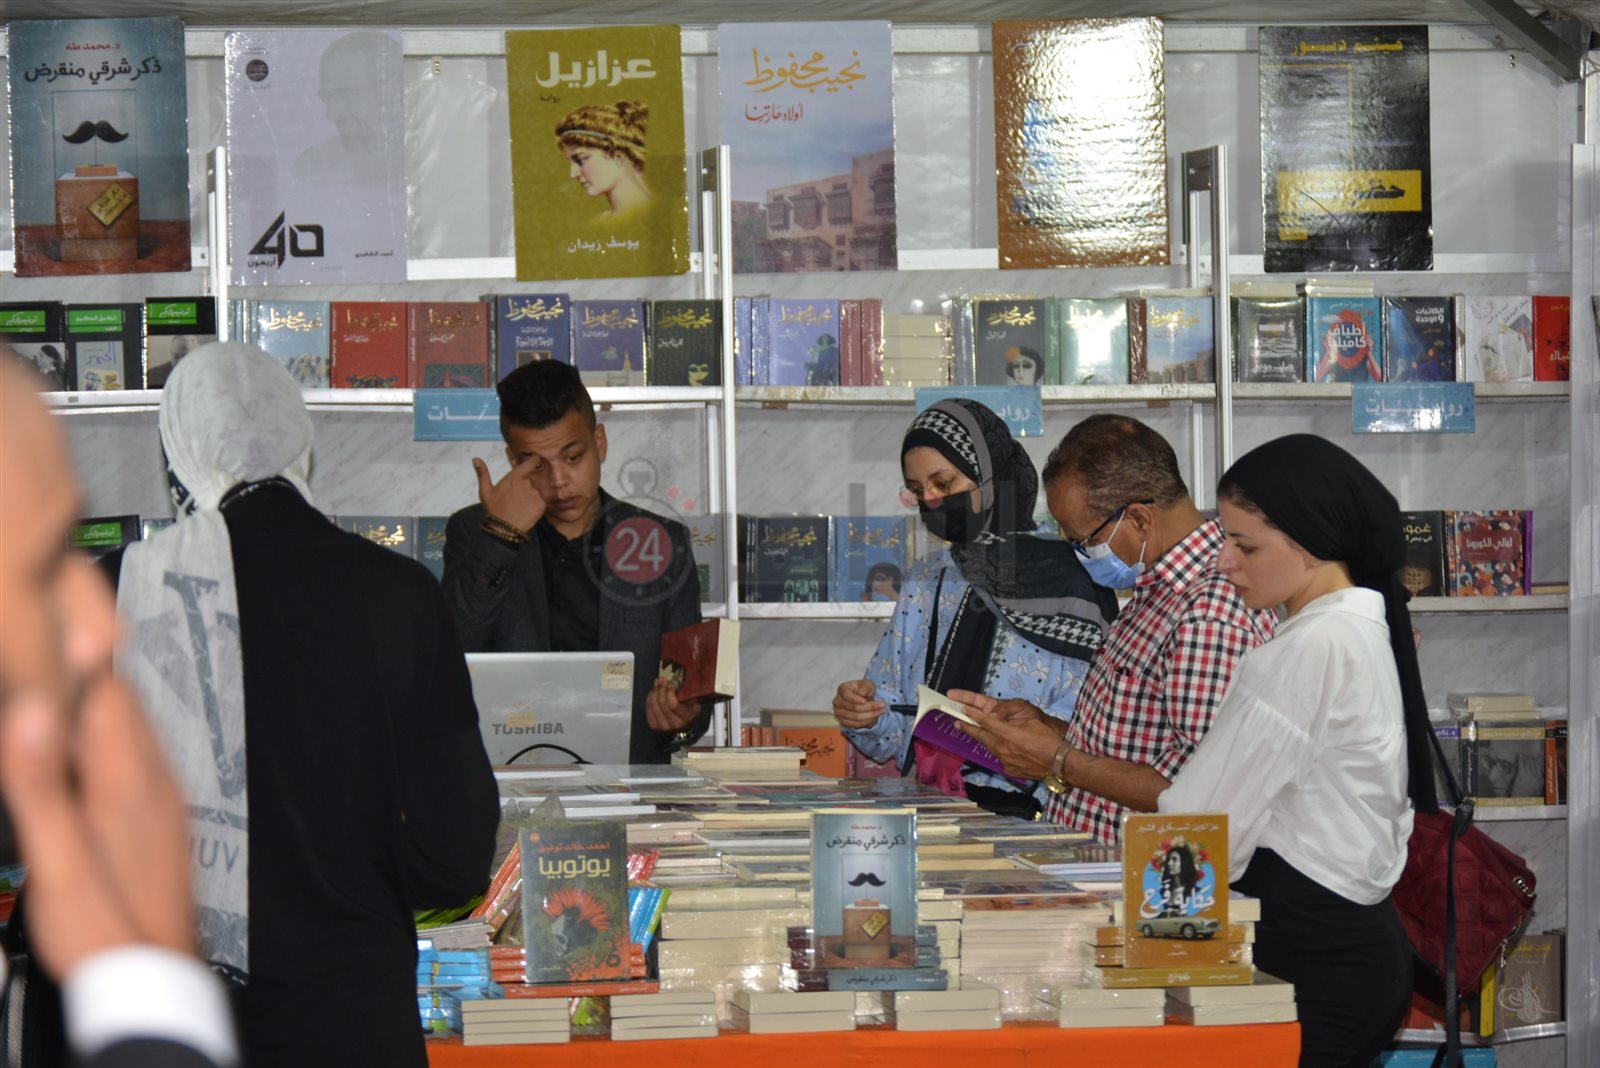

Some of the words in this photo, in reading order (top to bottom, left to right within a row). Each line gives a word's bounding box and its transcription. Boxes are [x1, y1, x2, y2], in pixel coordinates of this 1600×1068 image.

[24, 62, 85, 83] منقرض
[89, 58, 131, 85] شرقي
[130, 56, 162, 81] ذكر
[535, 49, 657, 89] عزازيل
[743, 47, 828, 94] محفوظ
[791, 50, 866, 94] نجيب
[567, 238, 602, 253] زيدان
[606, 235, 640, 251] يوسف
[505, 297, 546, 321] محفوظ
[528, 298, 564, 321] نجيب
[1466, 537, 1492, 550] الكورونا
[1493, 536, 1513, 550] ليالي
[492, 722, 564, 735] TOSHIBA
[826, 836, 862, 849] منقرض
[863, 834, 889, 851] شرقي
[888, 834, 906, 849] ذكر
[539, 855, 611, 879] يوتوبيا
